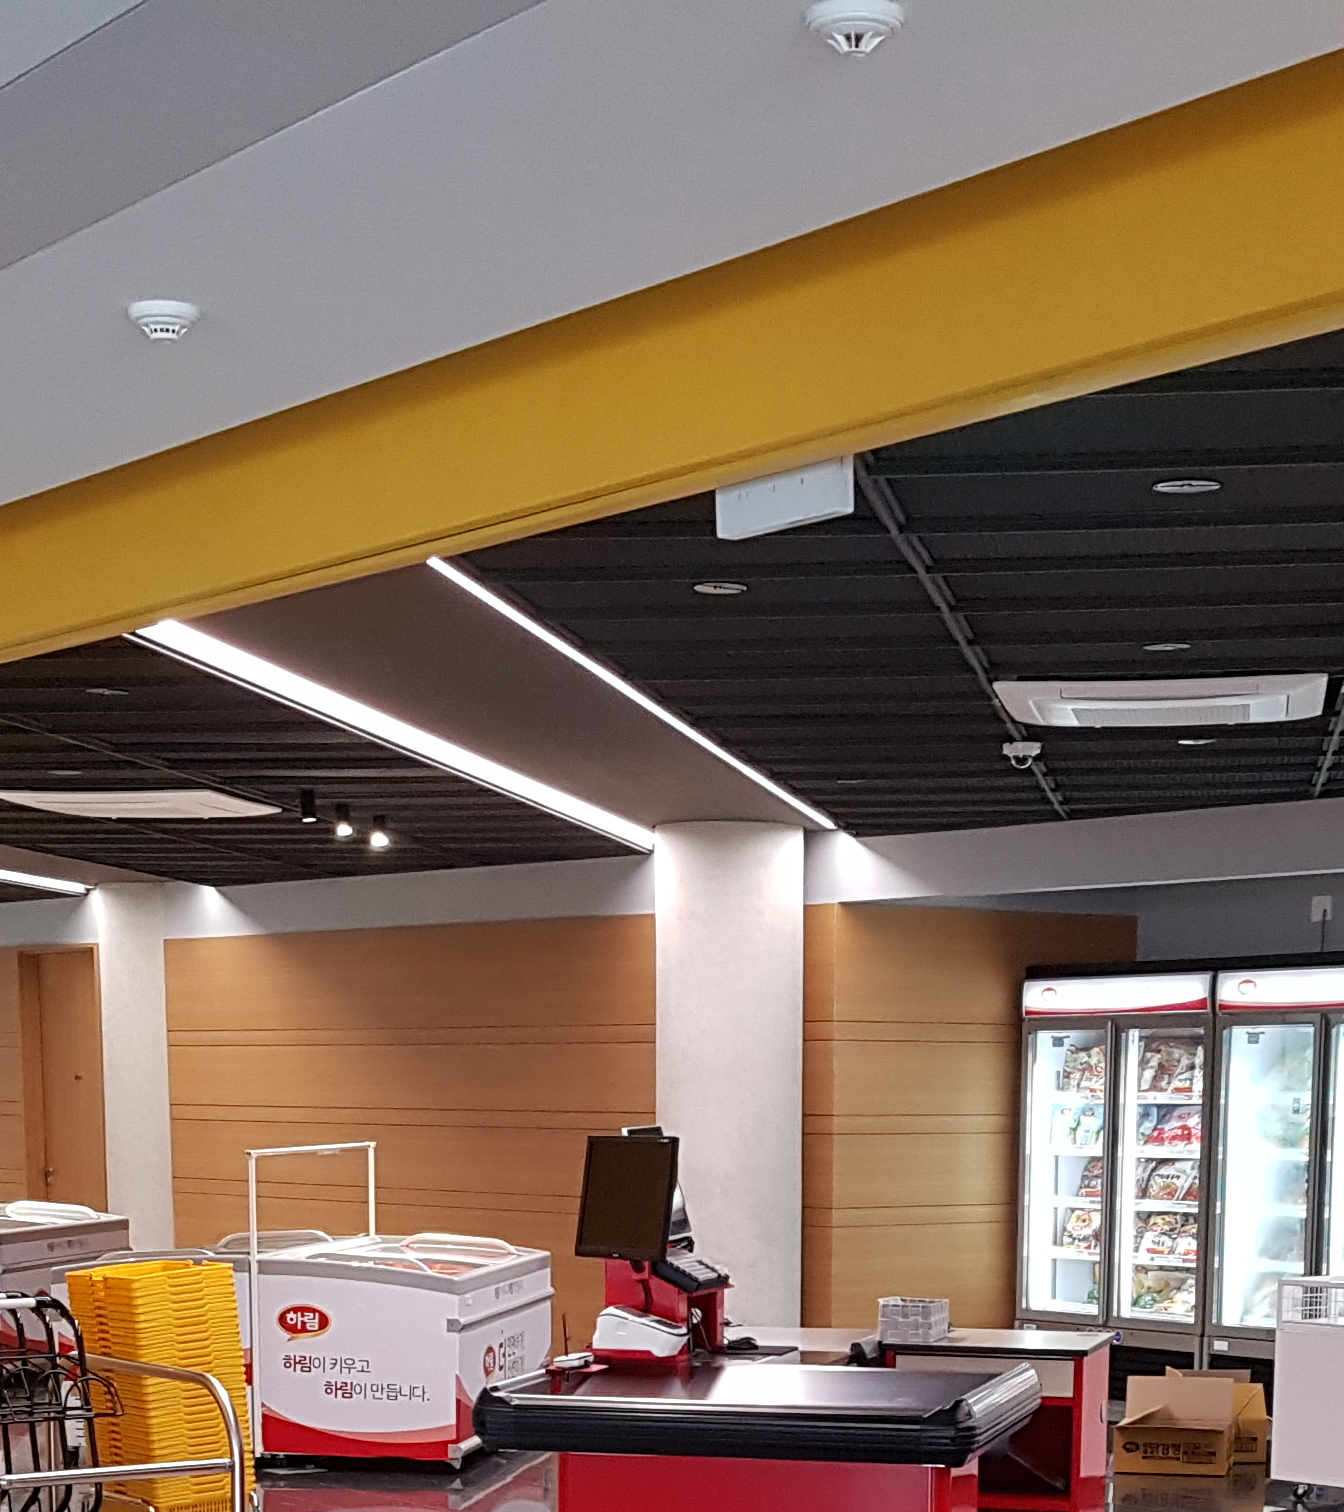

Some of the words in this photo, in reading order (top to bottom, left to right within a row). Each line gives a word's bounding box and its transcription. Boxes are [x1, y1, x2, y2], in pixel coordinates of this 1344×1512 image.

[286, 1311, 318, 1330] 하림
[282, 1354, 326, 1374] 하림이
[329, 1356, 372, 1375] 키우고
[323, 1380, 367, 1400] 하림이
[370, 1382, 431, 1402] 만듭니다.
